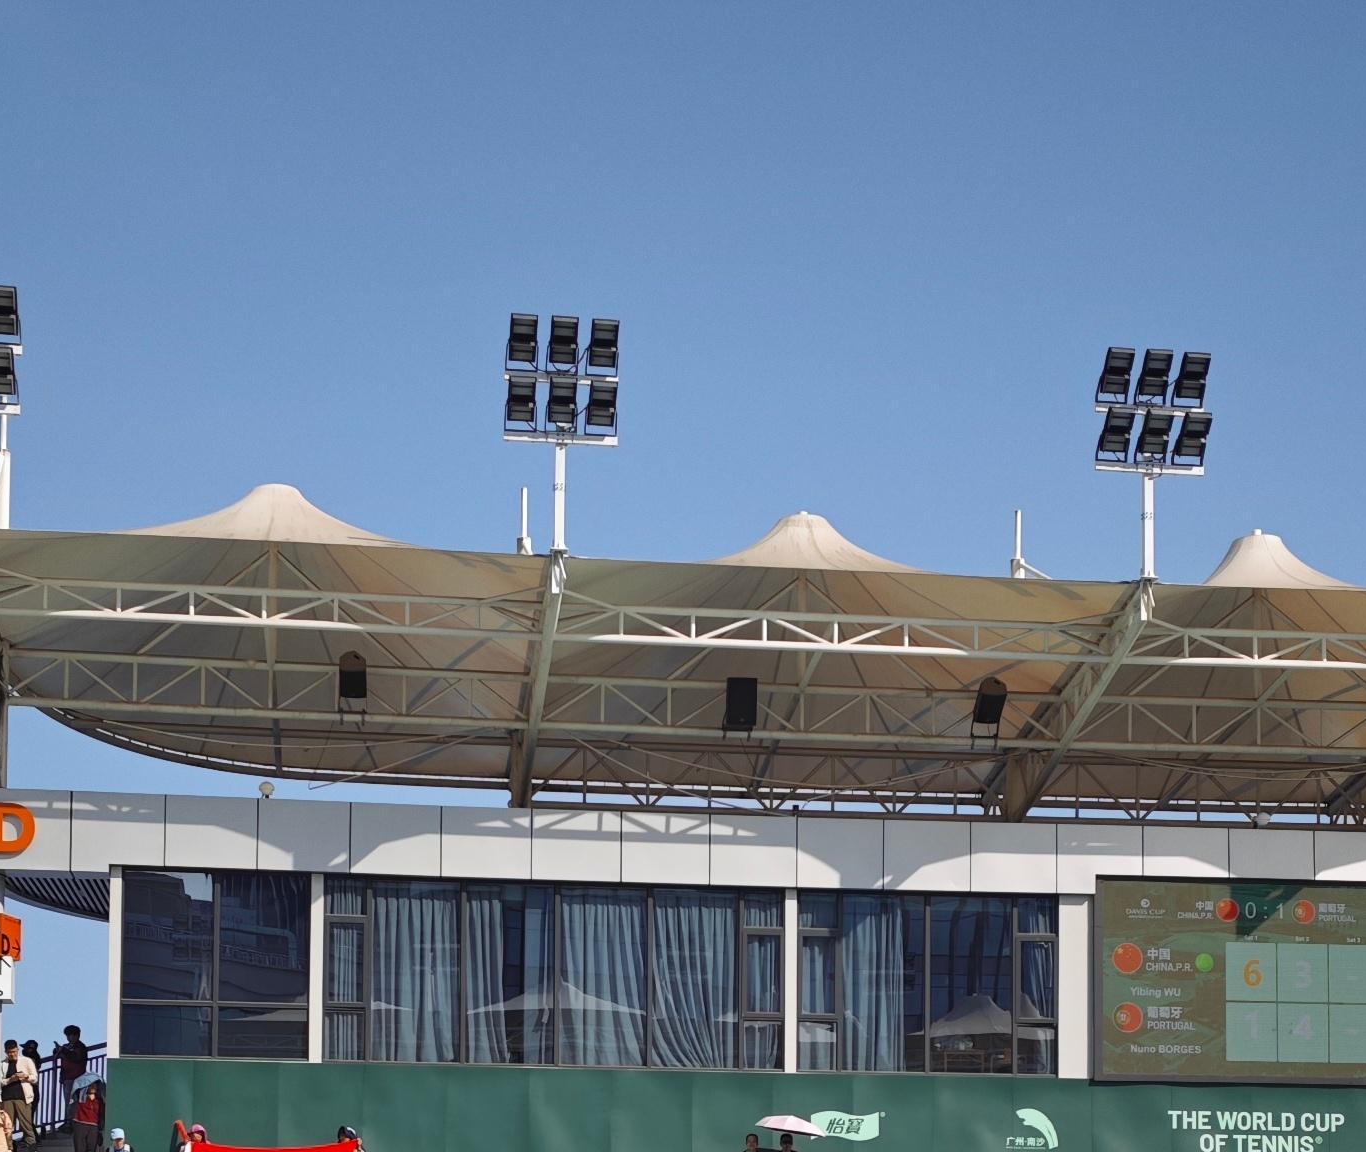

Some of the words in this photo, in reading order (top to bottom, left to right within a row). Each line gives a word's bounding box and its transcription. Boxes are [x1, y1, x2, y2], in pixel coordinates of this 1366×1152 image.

[1195, 900, 1214, 911] 中国
[1318, 914, 1357, 923] PORTUGAL
[1, 933, 11, 955] D
[1147, 947, 1171, 961] 中国
[1146, 962, 1194, 972] CHINA.P.R.
[1243, 959, 1264, 989] 6
[1130, 986, 1162, 998] Yibing
[1164, 987, 1181, 997] WU
[1147, 1006, 1183, 1019] 葡萄牙
[1147, 1021, 1196, 1031] PORTUGAL
[1130, 1044, 1156, 1054] Nuno
[1158, 1045, 1202, 1054] BORGES
[1167, 1110, 1212, 1130] THE
[1216, 1111, 1296, 1132] WORLD
[1300, 1112, 1345, 1132] CUP
[1199, 1134, 1228, 1152] OF
